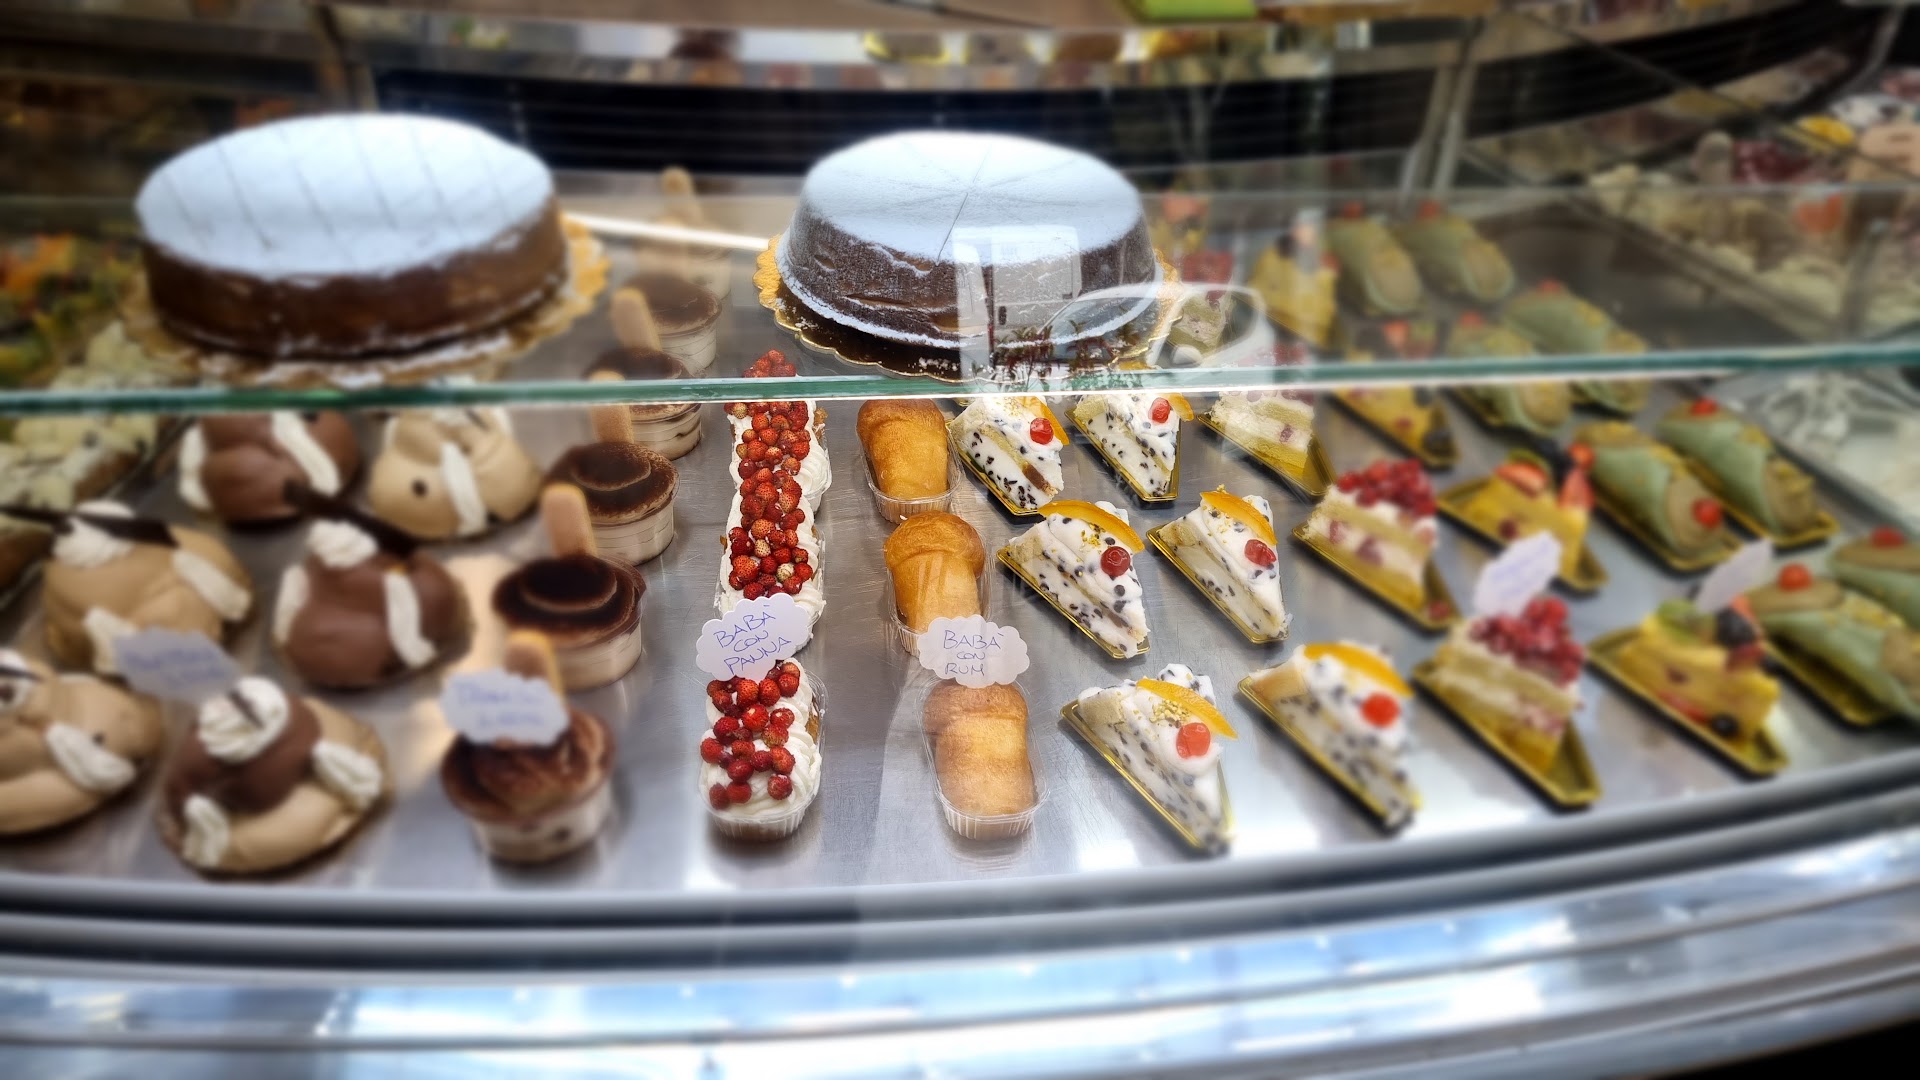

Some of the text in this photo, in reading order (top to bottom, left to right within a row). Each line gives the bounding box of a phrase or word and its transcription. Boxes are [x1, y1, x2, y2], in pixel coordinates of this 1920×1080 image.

[733, 630, 769, 652] CON
[724, 637, 792, 675] PANNA
[956, 651, 986, 660] CON
[945, 662, 985, 676] RUM
